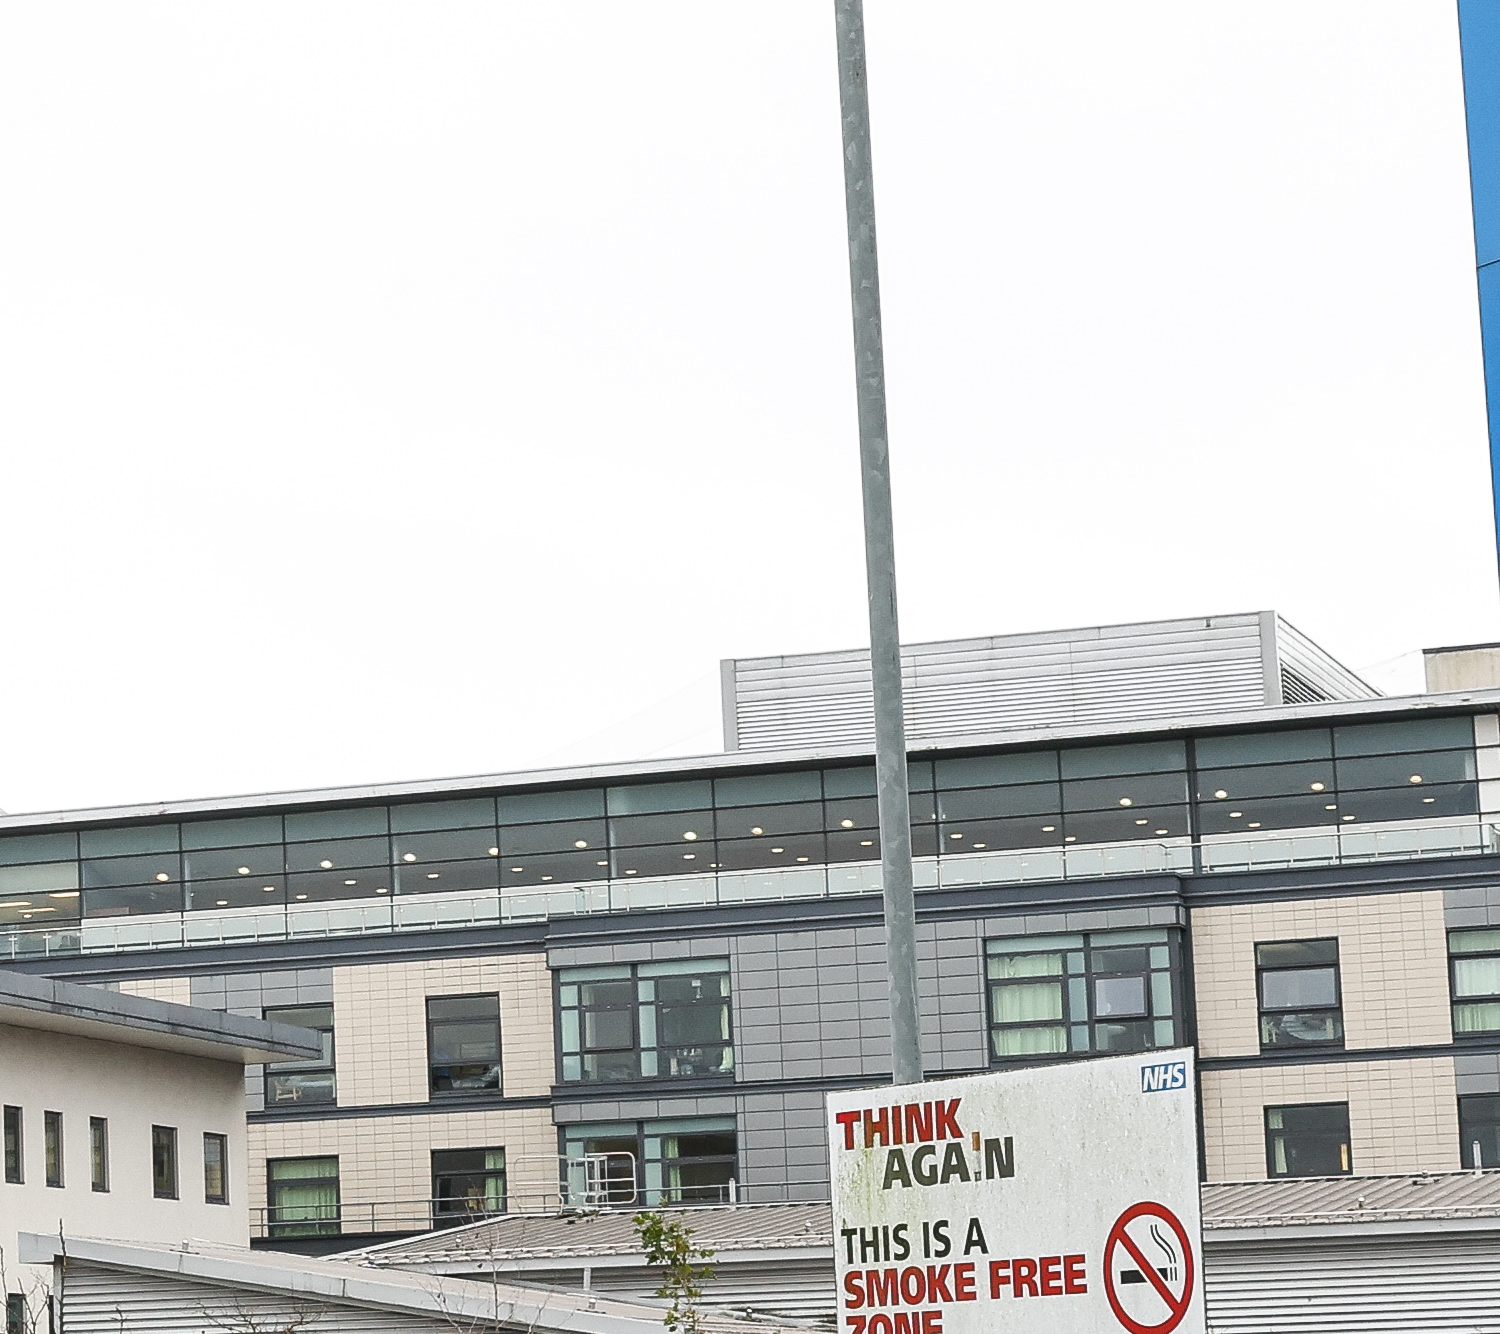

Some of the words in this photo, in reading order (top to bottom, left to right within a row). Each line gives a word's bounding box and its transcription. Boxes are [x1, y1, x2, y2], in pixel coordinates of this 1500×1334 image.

[1143, 1062, 1185, 1091] NHS
[836, 1098, 964, 1150] THINK
[841, 1222, 910, 1264] THIS
[923, 1219, 951, 1258] IS
[964, 1218, 989, 1256] A
[844, 1262, 976, 1310] SMOKE
[990, 1254, 1088, 1300] FREE
